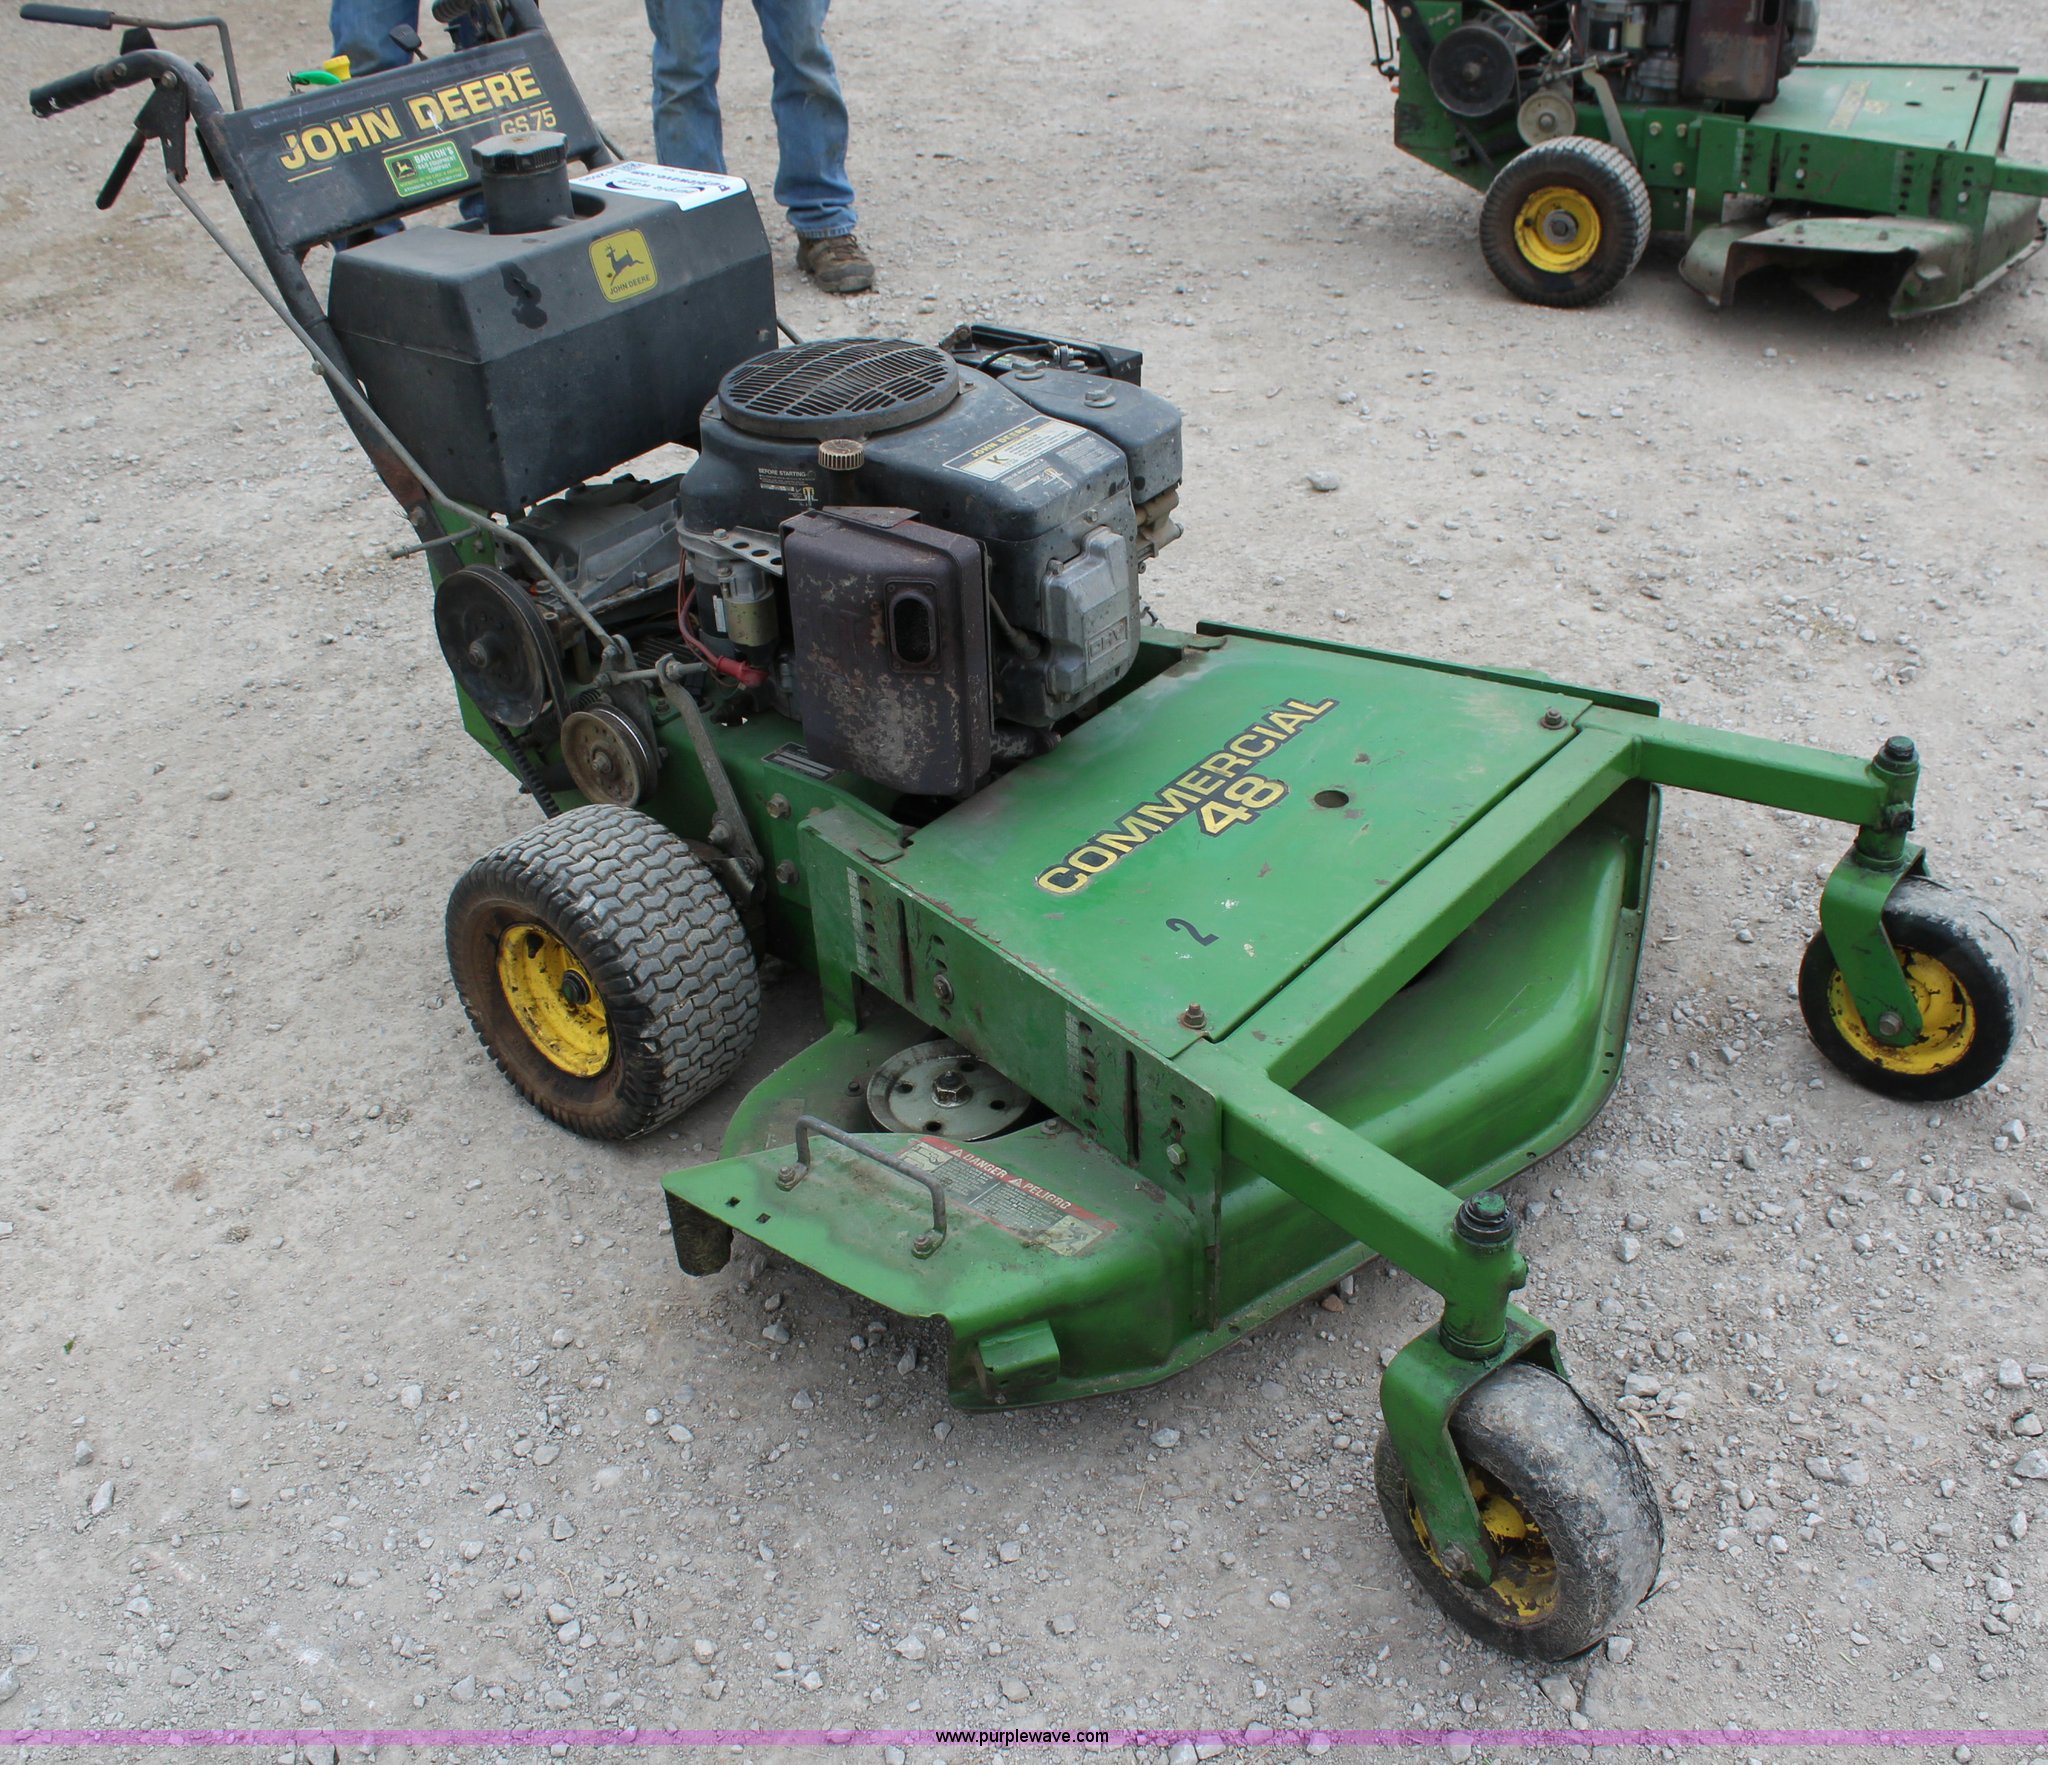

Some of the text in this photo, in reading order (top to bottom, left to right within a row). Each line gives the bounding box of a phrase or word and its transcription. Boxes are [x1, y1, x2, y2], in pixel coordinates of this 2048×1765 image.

[280, 67, 542, 170] JOHN DEERE
[414, 147, 453, 163] BARTON'S
[610, 274, 651, 294] JOHN DEERE
[971, 440, 999, 458] JOHN
[998, 425, 1032, 444] DEERE
[758, 467, 779, 476] BEFORE
[1037, 699, 1335, 894] COMMERCIAL
[1199, 775, 1286, 835] 48
[1165, 917, 1220, 946] 2
[962, 1152, 1009, 1179] DANGER
[1022, 1182, 1072, 1210] PELIGRO
